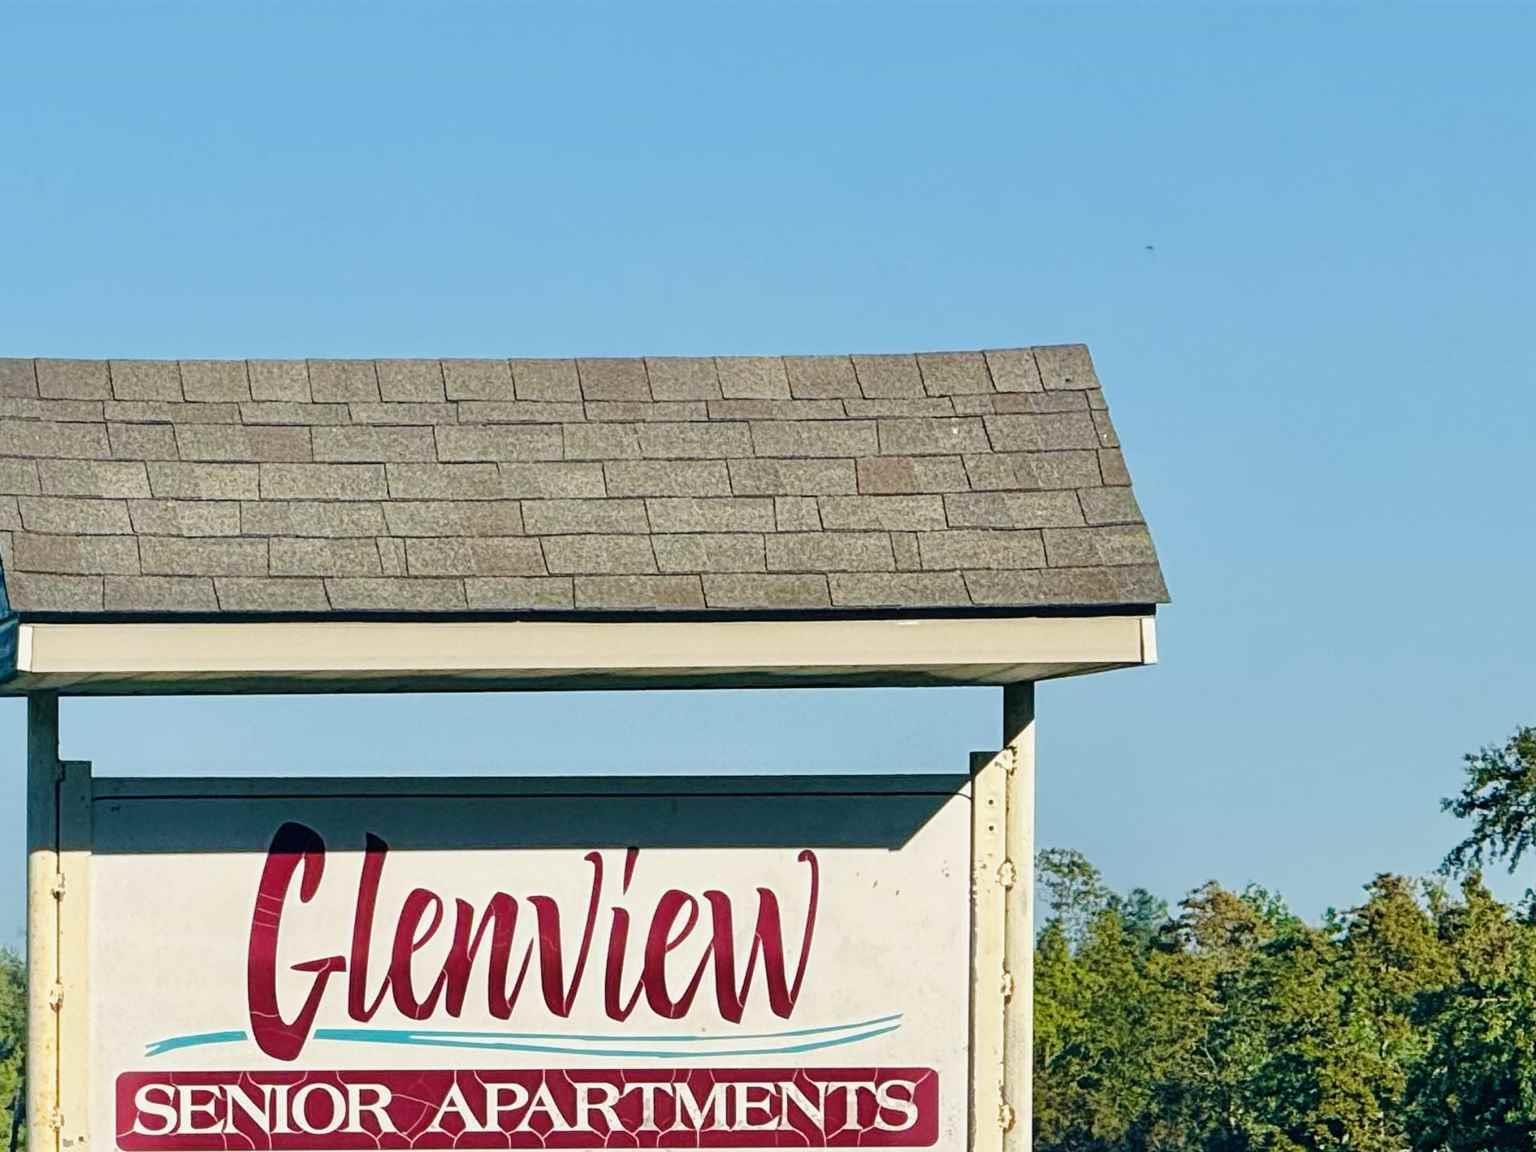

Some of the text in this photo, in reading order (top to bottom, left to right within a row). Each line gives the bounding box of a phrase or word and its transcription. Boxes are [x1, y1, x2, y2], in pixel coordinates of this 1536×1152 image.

[248, 821, 816, 1062] Glenview
[132, 1080, 919, 1138] SENIOR APARTMENTS
